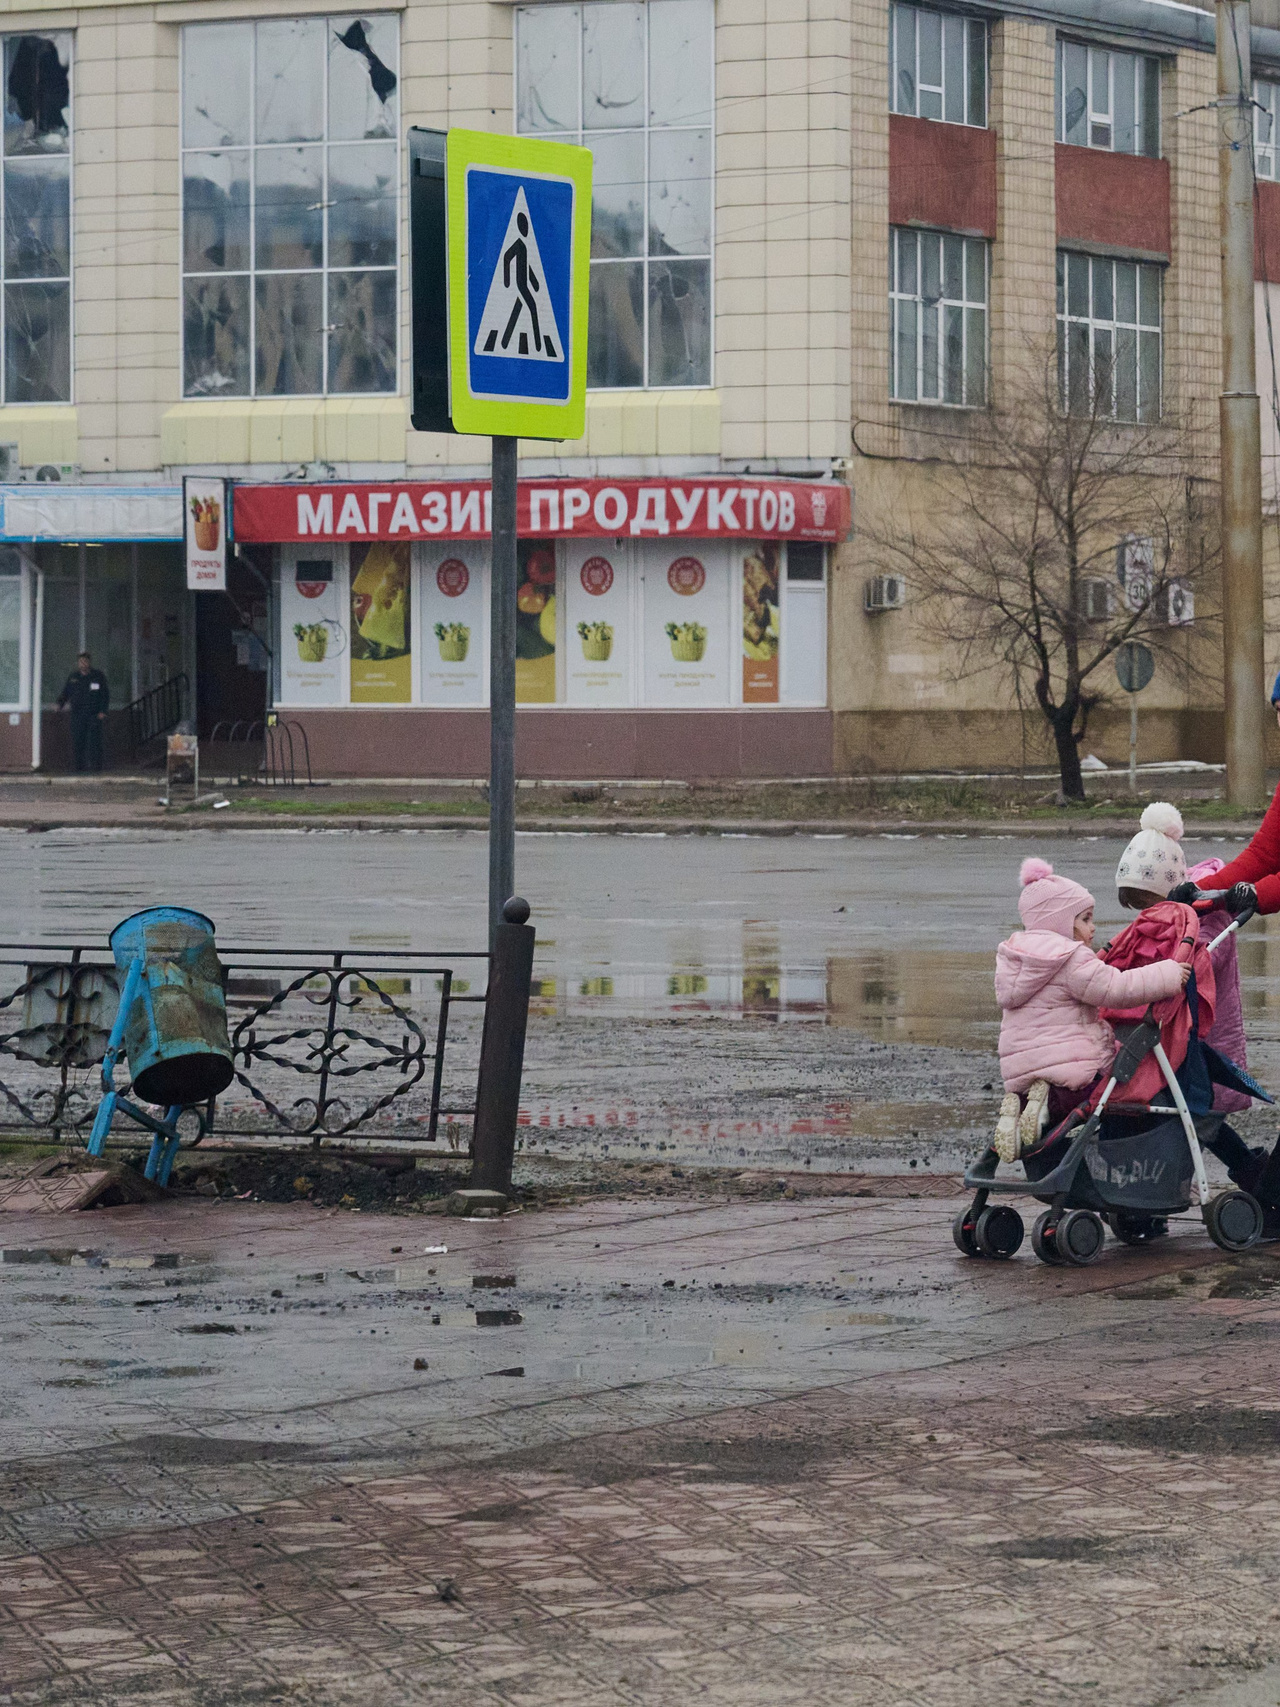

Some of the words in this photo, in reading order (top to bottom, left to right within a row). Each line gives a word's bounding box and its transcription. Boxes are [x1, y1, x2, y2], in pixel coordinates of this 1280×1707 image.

[297, 491, 492, 535] МАГАЗИ
[530, 487, 796, 535] ПРОДУКТОВ
[191, 560, 221, 568] ПРОДУКТЫ
